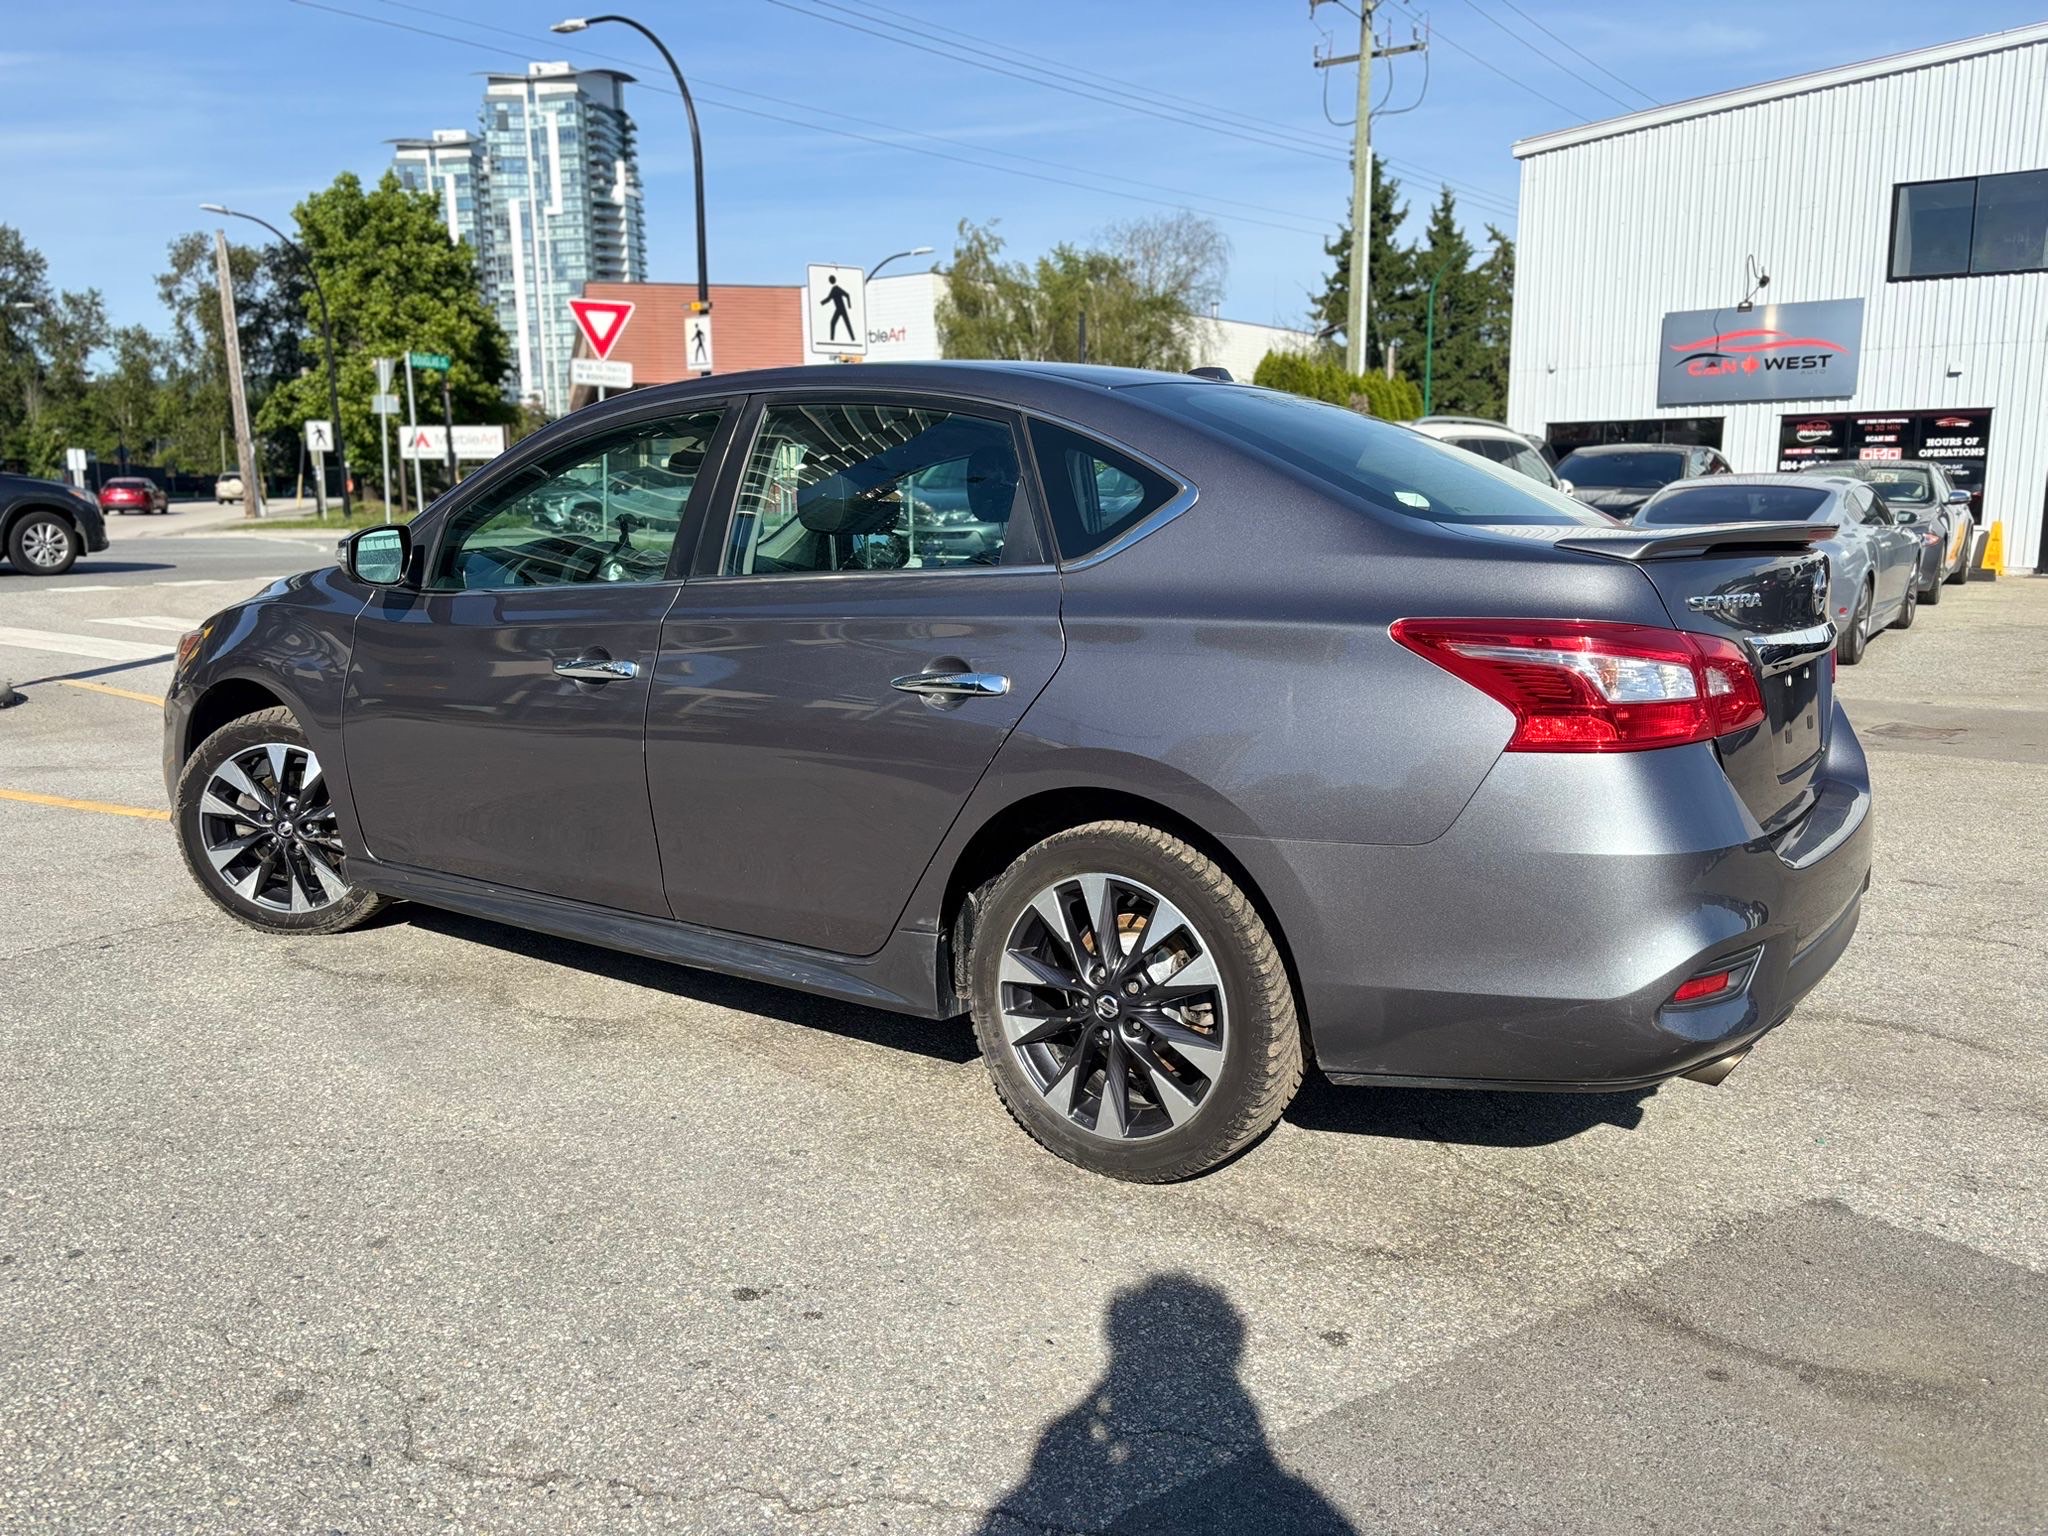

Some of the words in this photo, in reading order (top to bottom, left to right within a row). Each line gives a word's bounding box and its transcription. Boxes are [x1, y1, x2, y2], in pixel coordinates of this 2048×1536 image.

[868, 327, 906, 344] bleArt
[1764, 354, 1833, 371] WEST
[434, 432, 499, 446] MrbleArt
[1926, 438, 1962, 447] HOURS
[1964, 437, 1979, 445] OF
[1919, 448, 1985, 457] OPERATIONS
[1686, 593, 1762, 612] SENTRA
